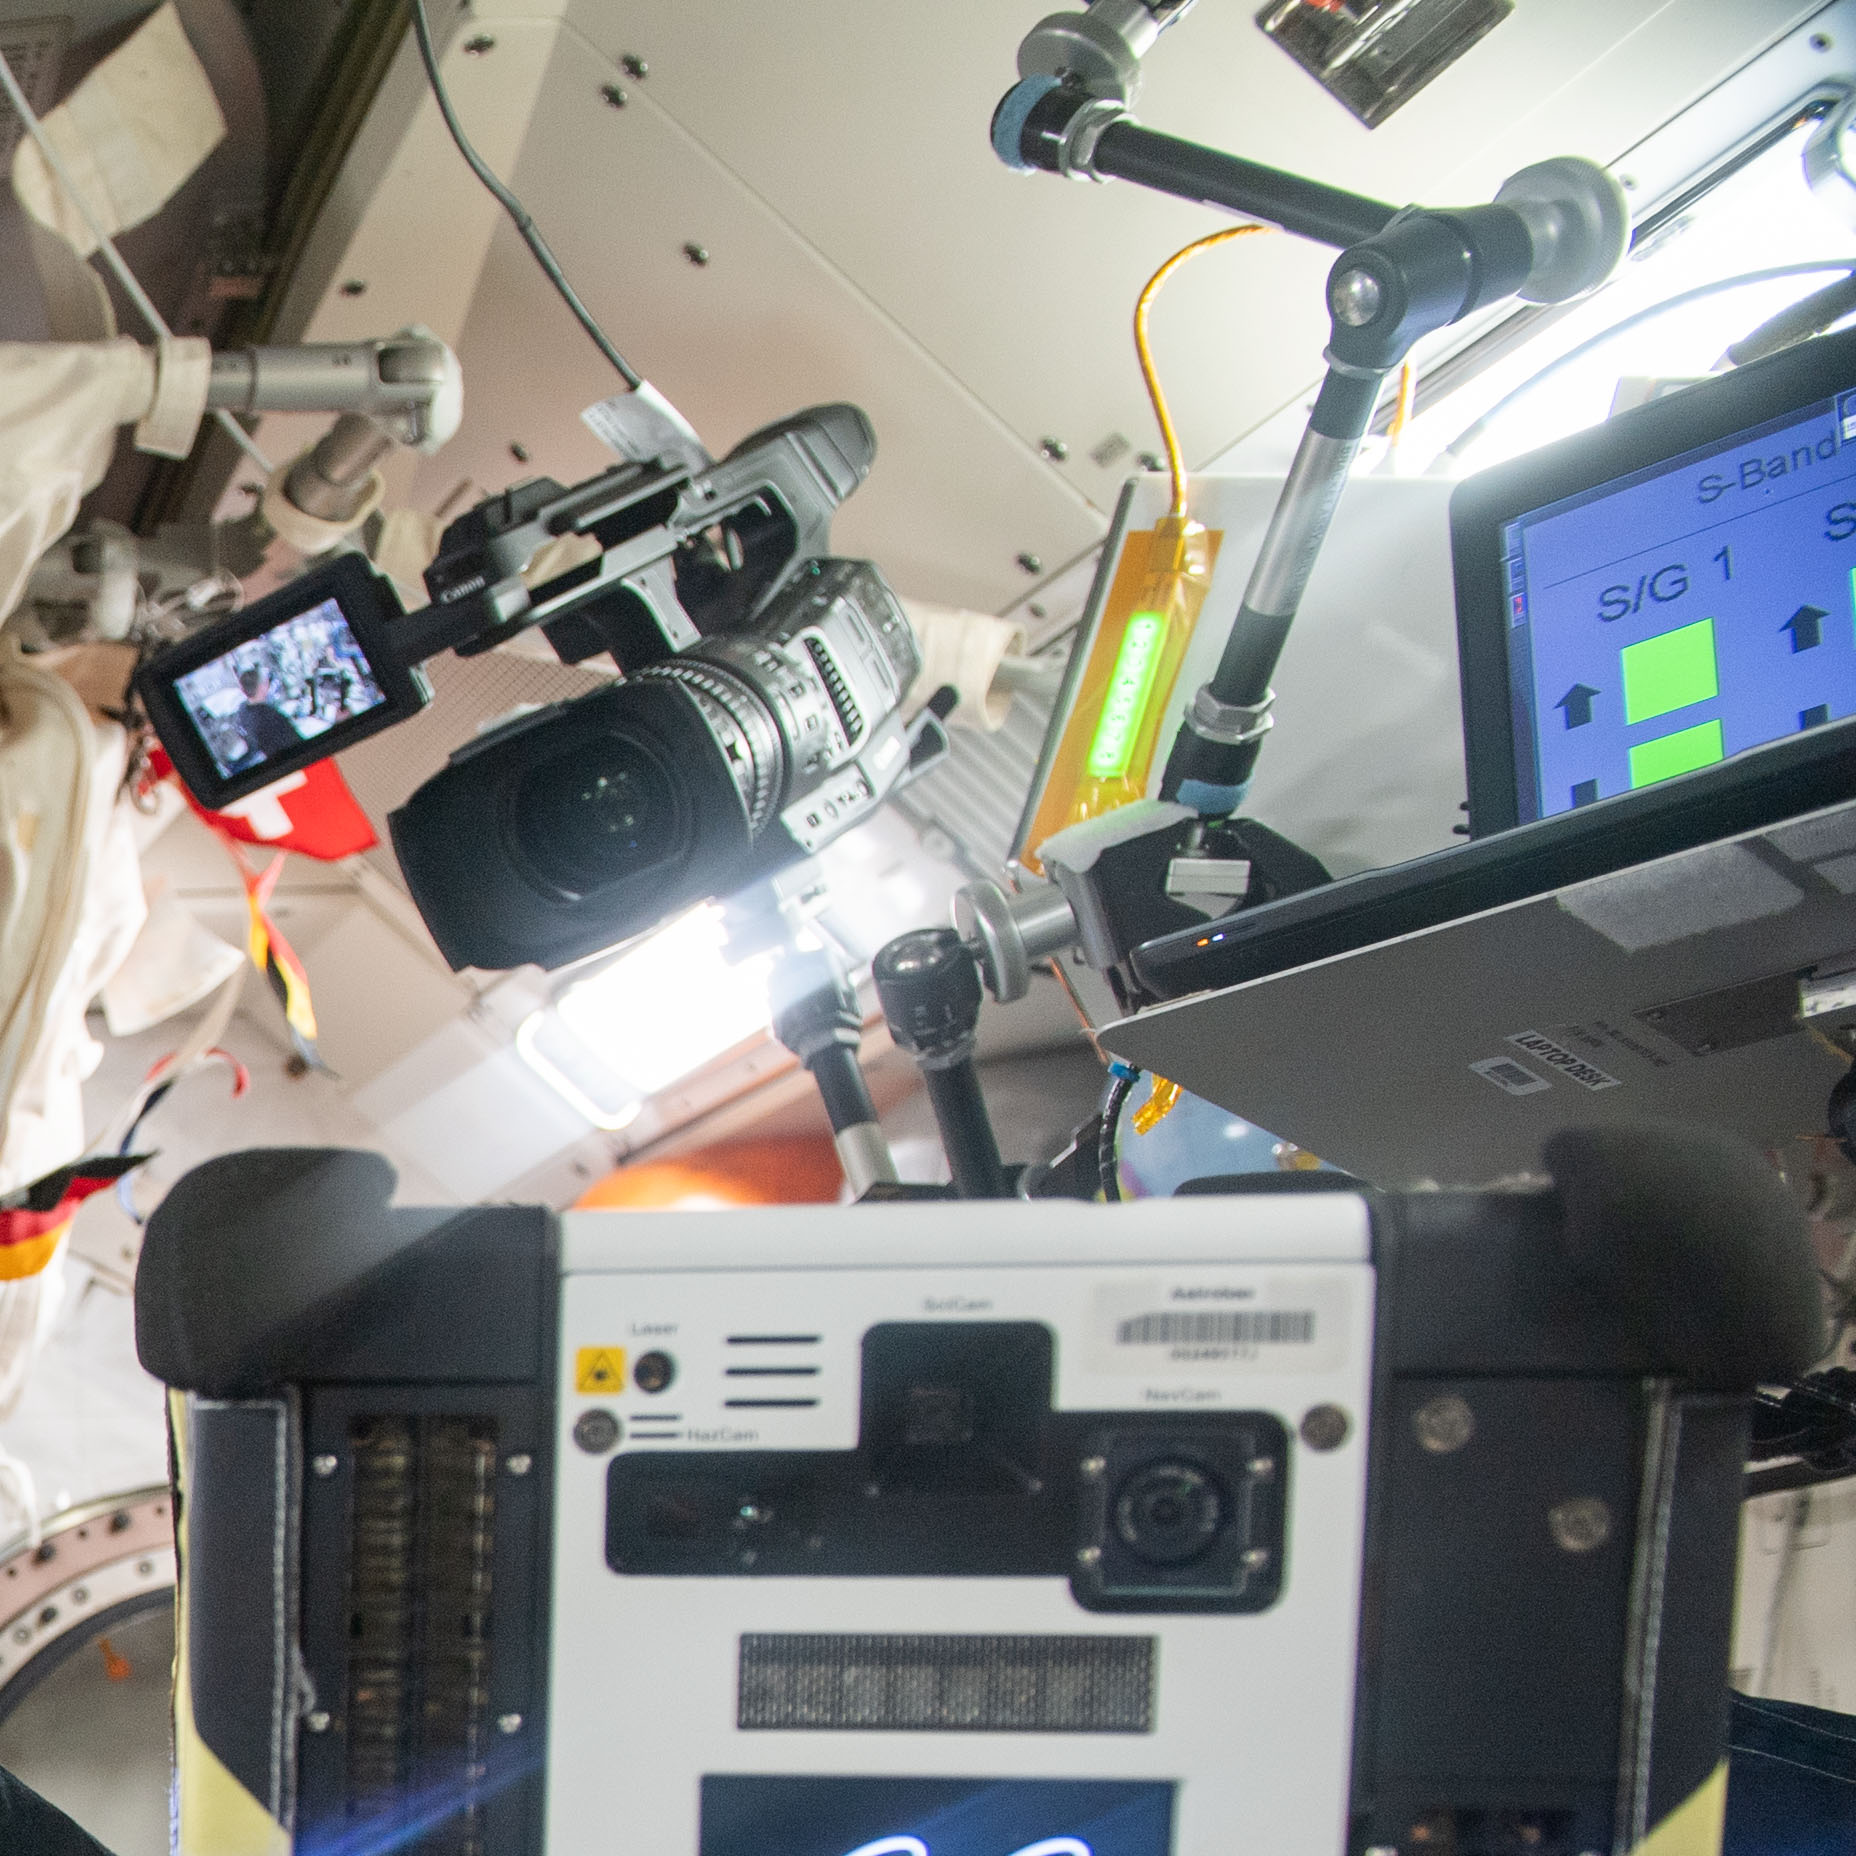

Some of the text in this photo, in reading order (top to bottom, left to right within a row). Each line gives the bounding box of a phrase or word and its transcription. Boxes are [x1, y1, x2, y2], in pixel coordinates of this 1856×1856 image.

[1697, 431, 1839, 504] S-Band
[439, 575, 486, 604] Canon
[1597, 544, 1734, 622] S/G 1
[1515, 1033, 1572, 1066] LAPTOP
[1564, 1062, 1611, 1087] DESK
